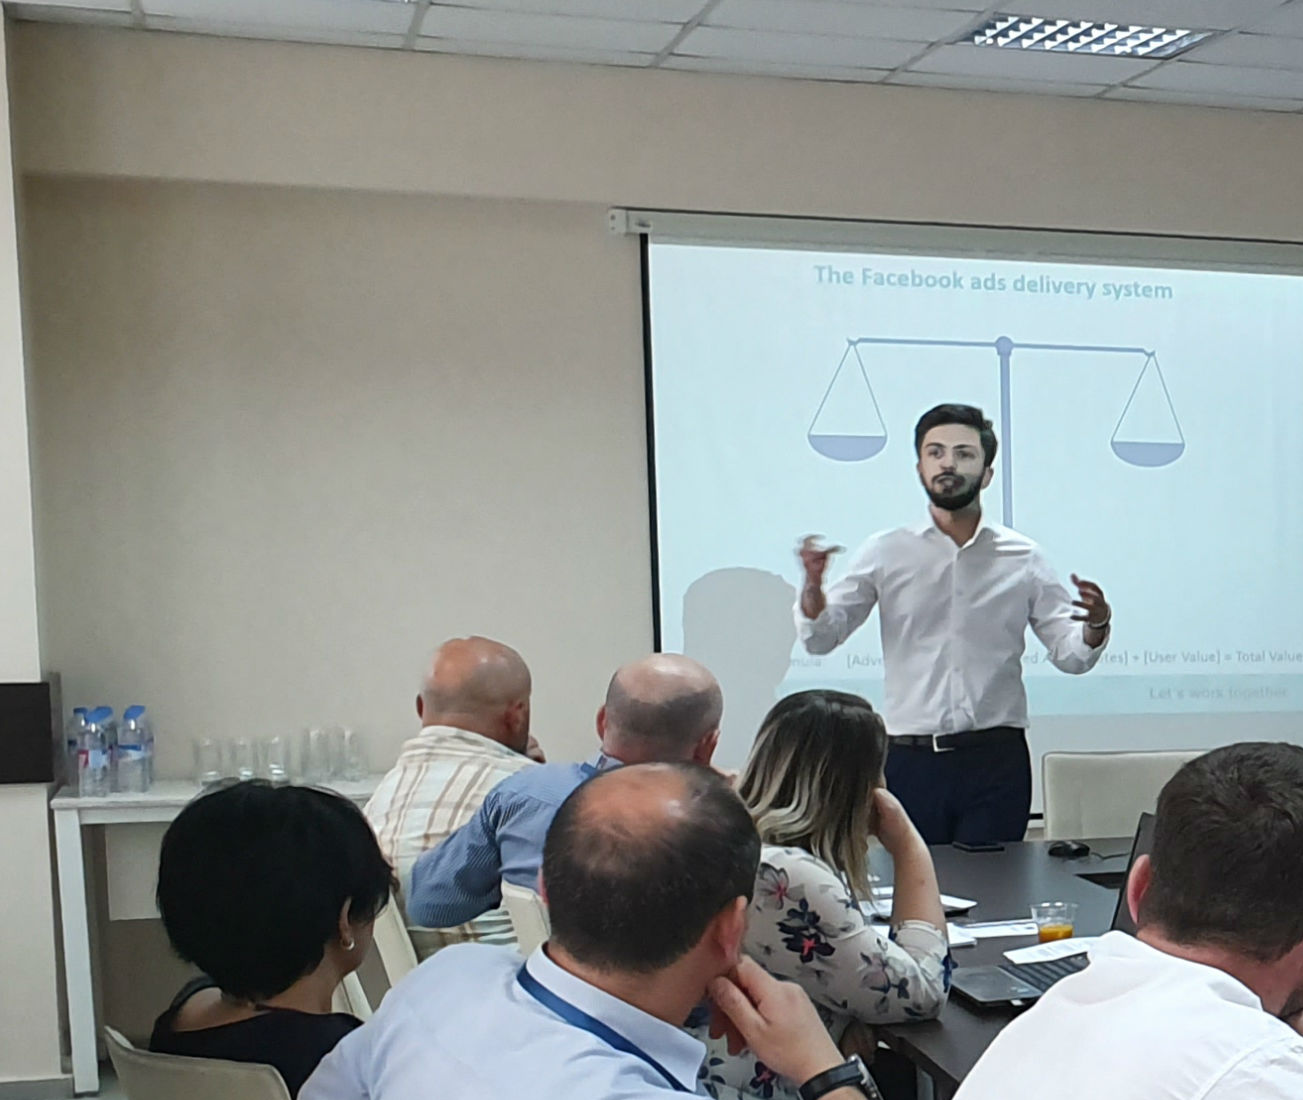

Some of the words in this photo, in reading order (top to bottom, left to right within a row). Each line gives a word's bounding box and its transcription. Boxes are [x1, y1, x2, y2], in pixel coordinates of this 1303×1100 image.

[814, 265, 855, 285] The
[861, 267, 965, 290] Facebook
[970, 274, 1006, 291] ads
[1013, 275, 1097, 300] delivery
[1102, 280, 1174, 301] system
[1144, 650, 1176, 665] [User
[1181, 650, 1220, 665] Value]
[1236, 650, 1265, 663] Total
[1269, 650, 1303, 663] Value
